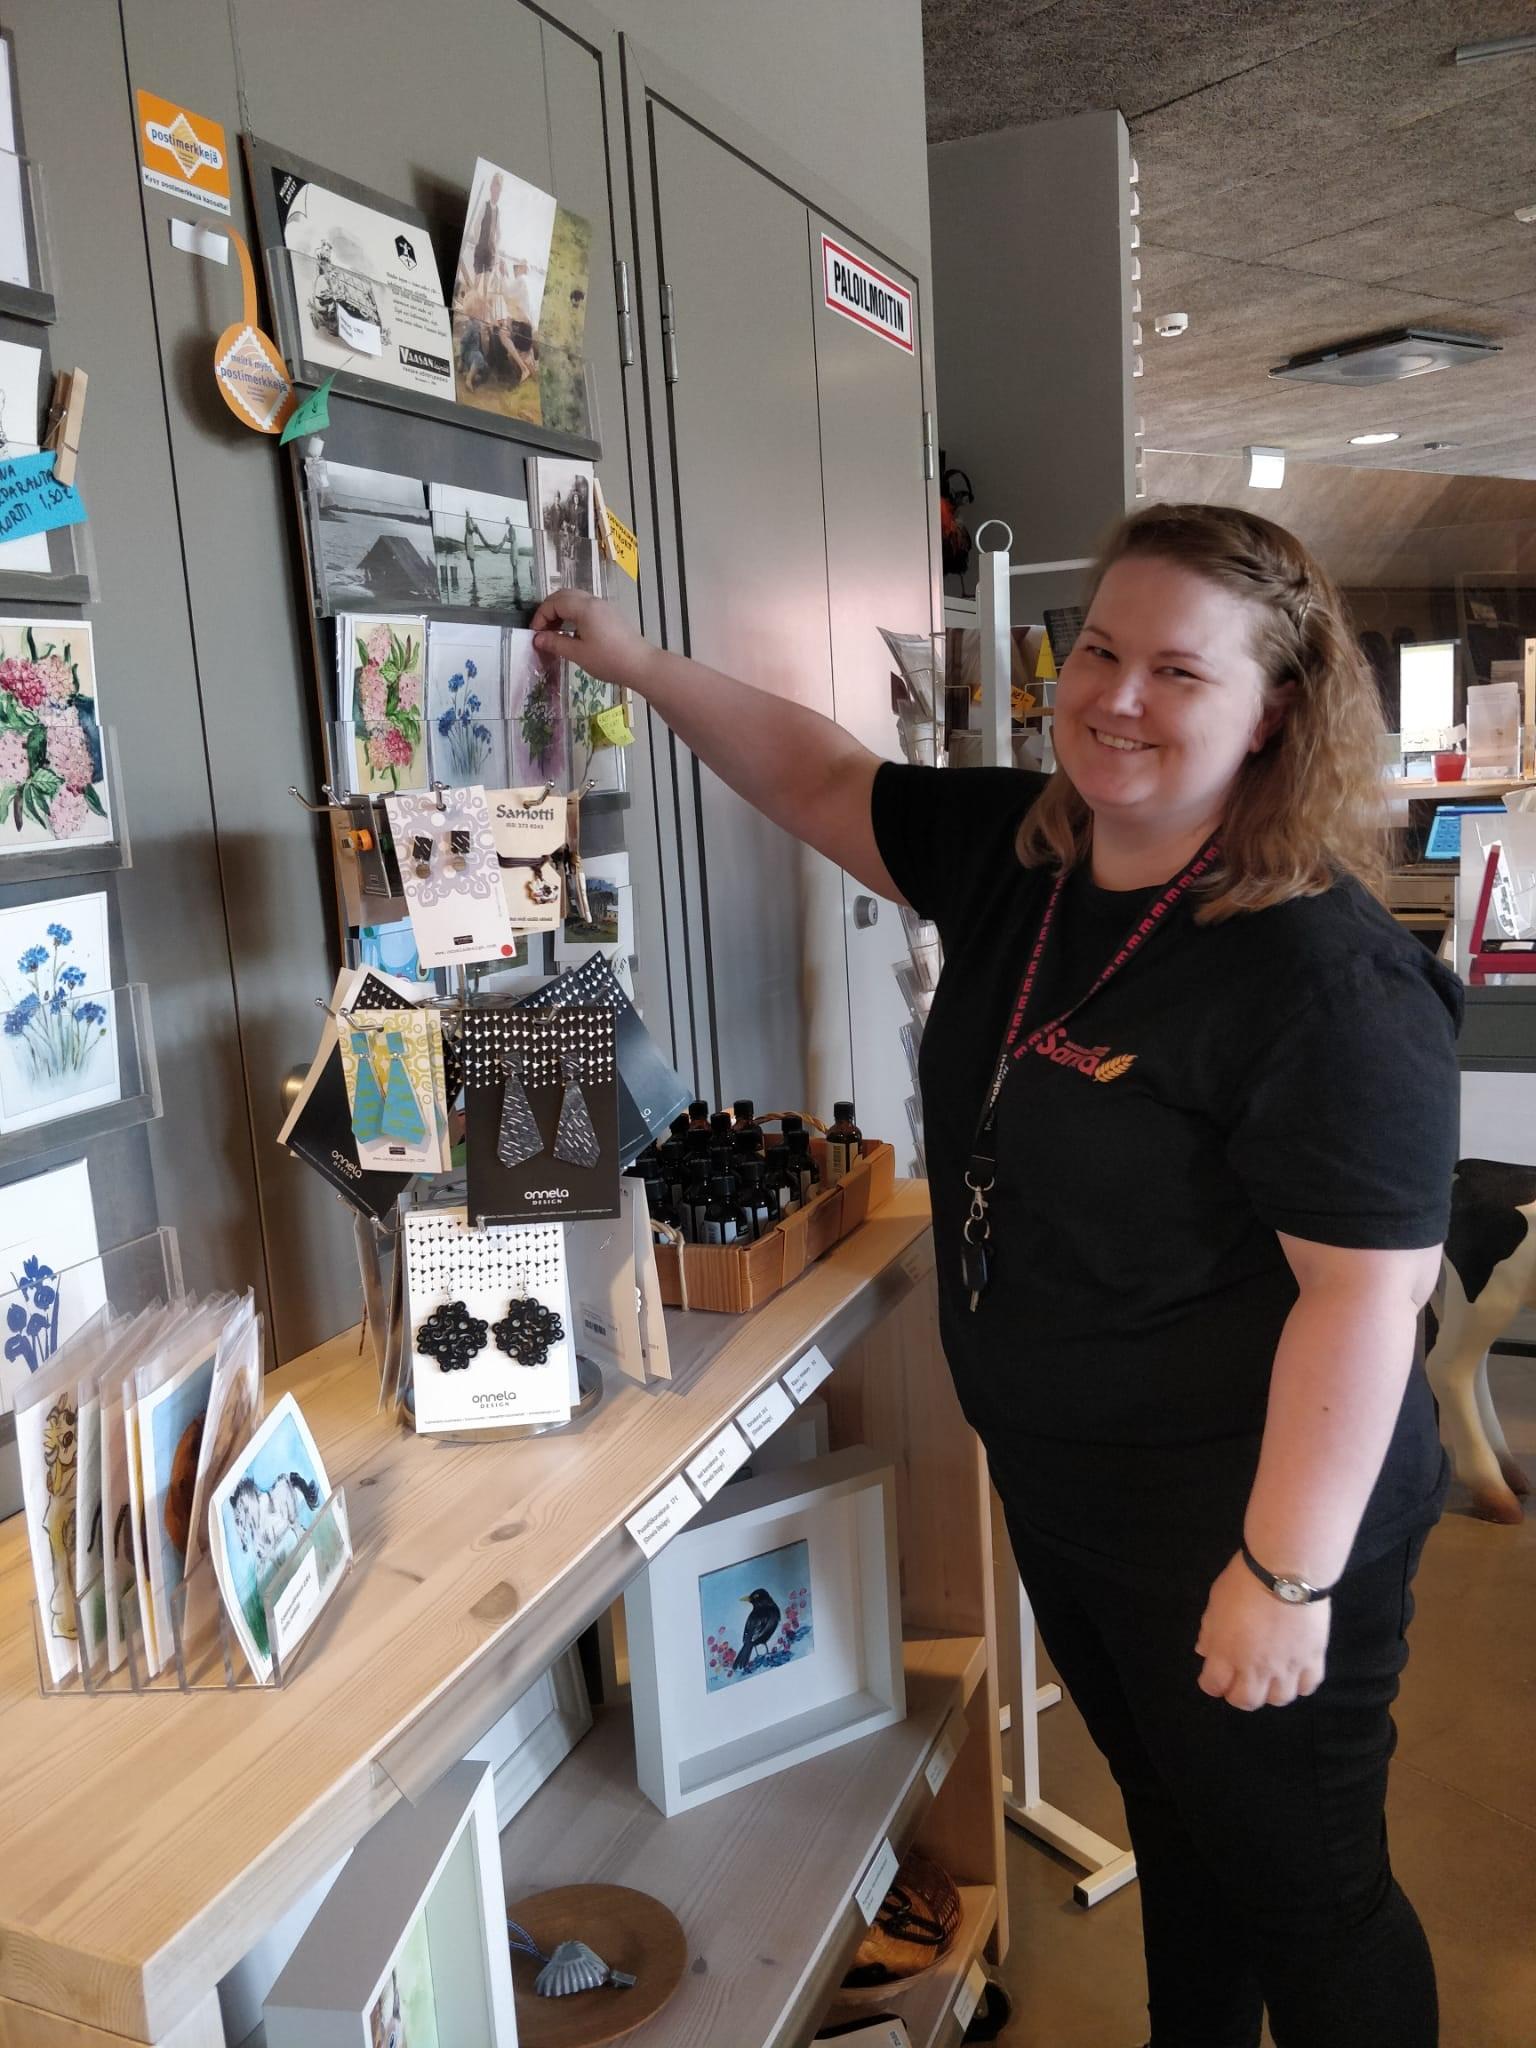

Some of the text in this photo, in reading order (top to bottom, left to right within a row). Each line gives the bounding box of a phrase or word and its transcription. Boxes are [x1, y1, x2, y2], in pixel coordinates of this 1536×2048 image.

[151, 129, 218, 163] postimerkkejä
[834, 260, 904, 332] PALOILMOITIN
[220, 367, 288, 394] postimerkkejä
[496, 804, 555, 821] Samotti
[331, 1150, 362, 1179] onnela
[524, 1187, 570, 1200] onnela
[472, 1390, 517, 1404] onnela
